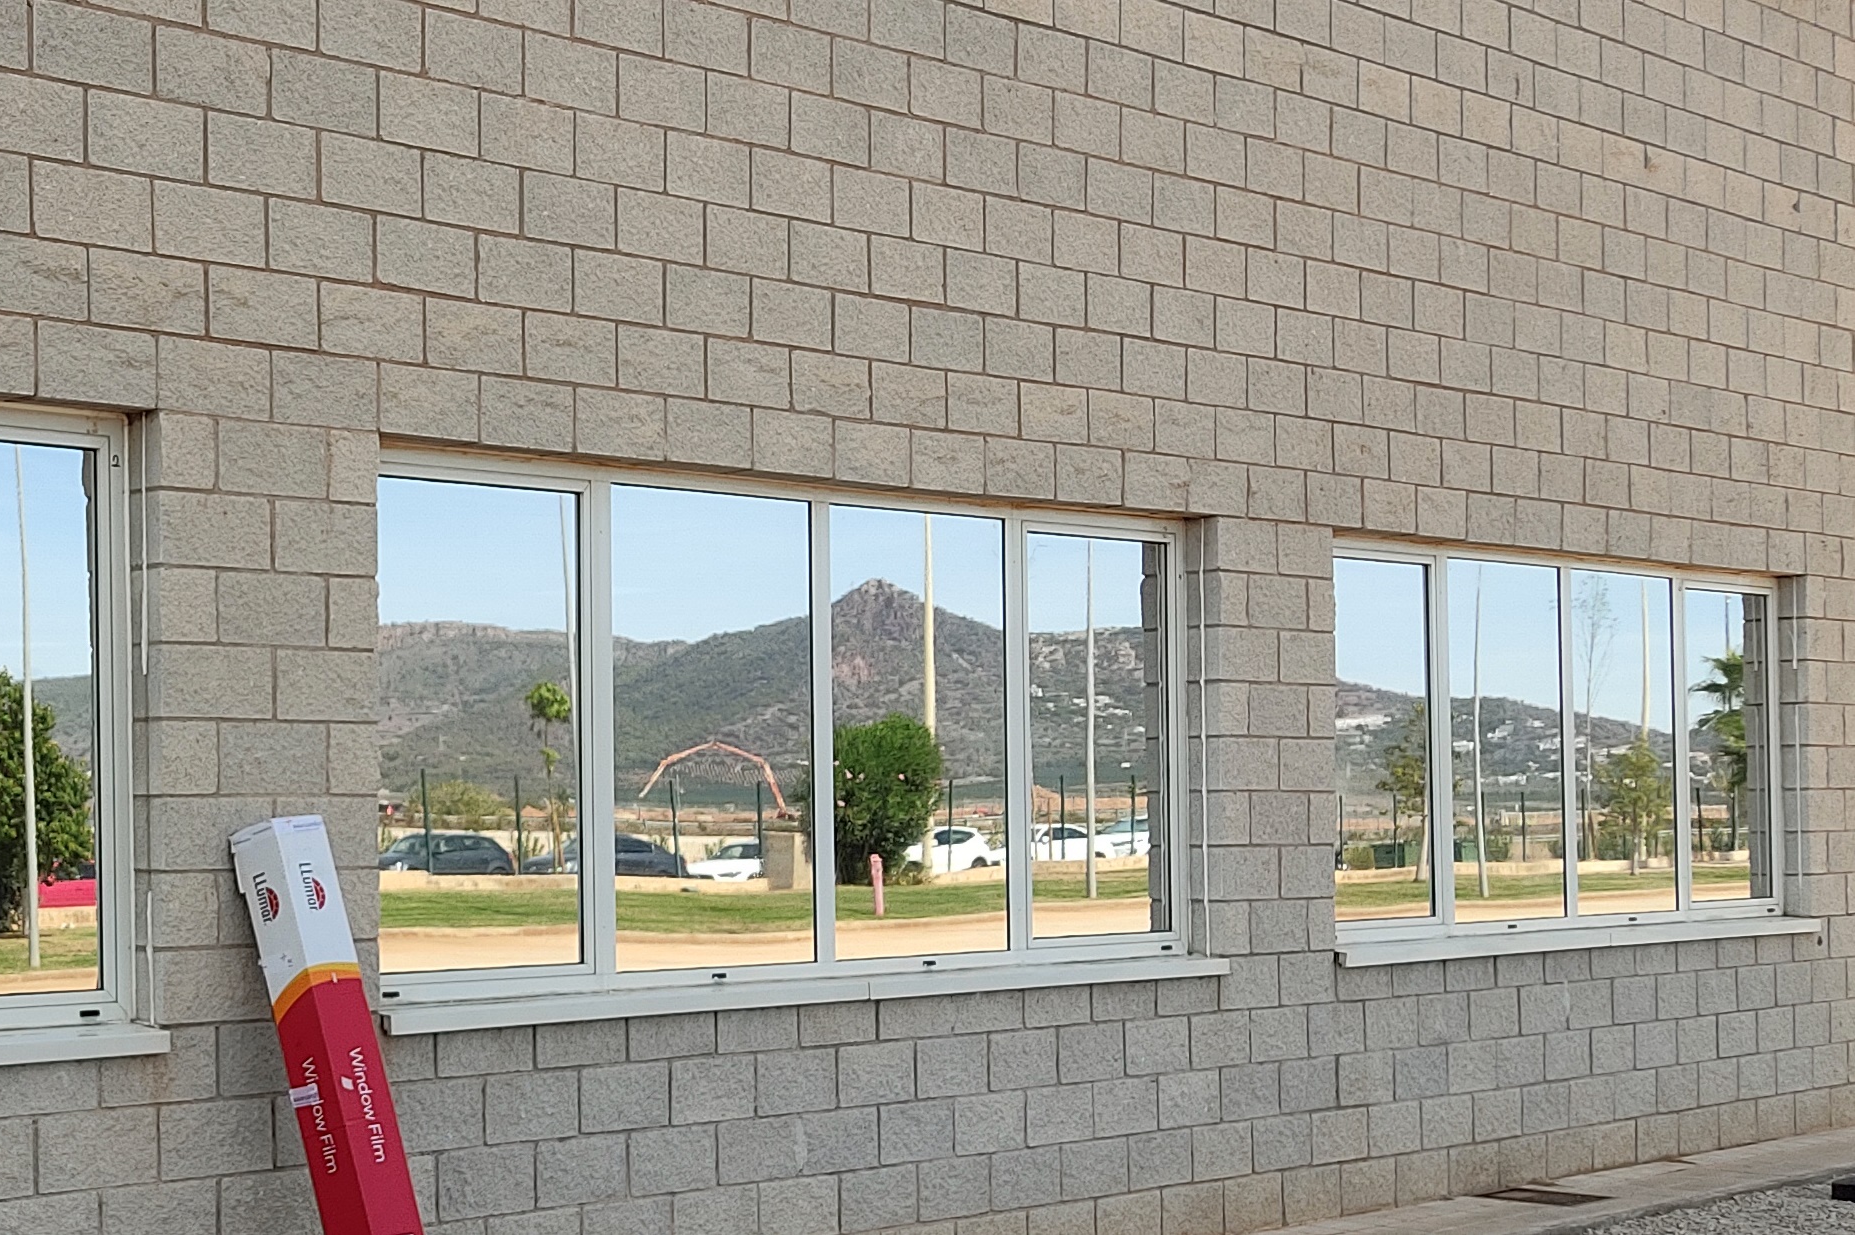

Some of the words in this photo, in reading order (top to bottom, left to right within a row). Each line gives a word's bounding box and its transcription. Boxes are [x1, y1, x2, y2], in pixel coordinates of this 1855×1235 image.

[252, 871, 273, 923] LLumar
[298, 862, 319, 911] LLumar
[302, 1056, 327, 1131] Wiow
[319, 1133, 338, 1174] Film
[349, 1046, 376, 1121] Window
[368, 1123, 386, 1163] Film
